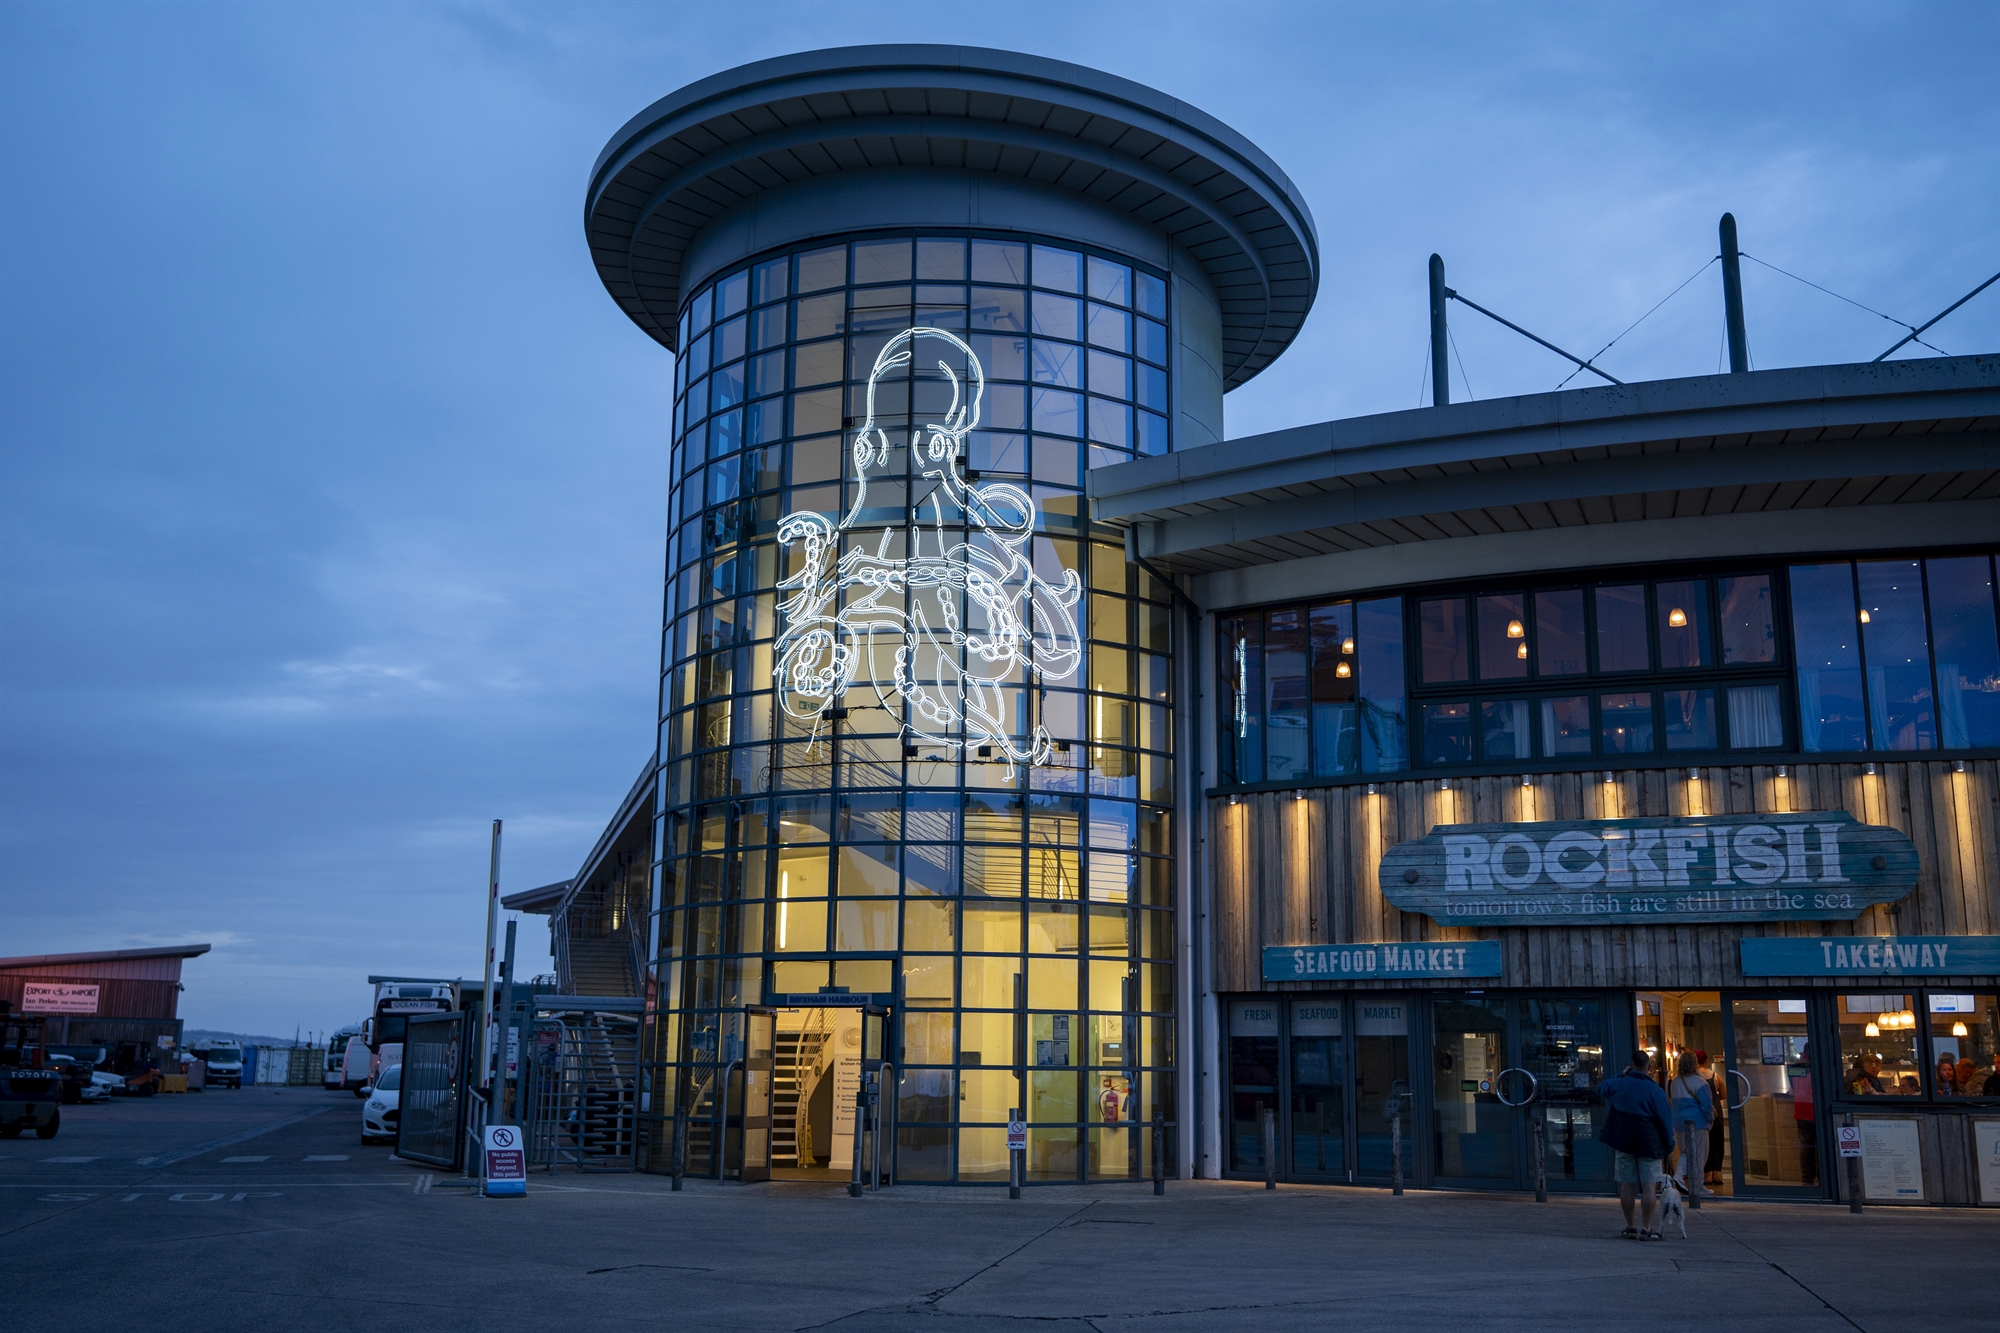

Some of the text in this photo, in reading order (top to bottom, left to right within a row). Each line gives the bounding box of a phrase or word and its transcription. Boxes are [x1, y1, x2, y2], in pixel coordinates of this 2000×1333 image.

[1442, 823, 1850, 891] ROCKFISH
[1444, 890, 1854, 916] tomorrow's fish are still in the sea
[1294, 946, 1466, 974] SEAFOOD MARKET
[1820, 941, 1948, 968] TAKEAWAY
[26, 986, 97, 997] EXPORT IMPORT
[789, 995, 868, 1004] BRIXHAM HARBOUR
[1244, 1007, 1402, 1021] FRESH SEAFOOD MARKET
[451, 1049, 456, 1070] 5
[11, 1071, 51, 1079] TOYOTA
[36, 1192, 286, 1202] STOP
